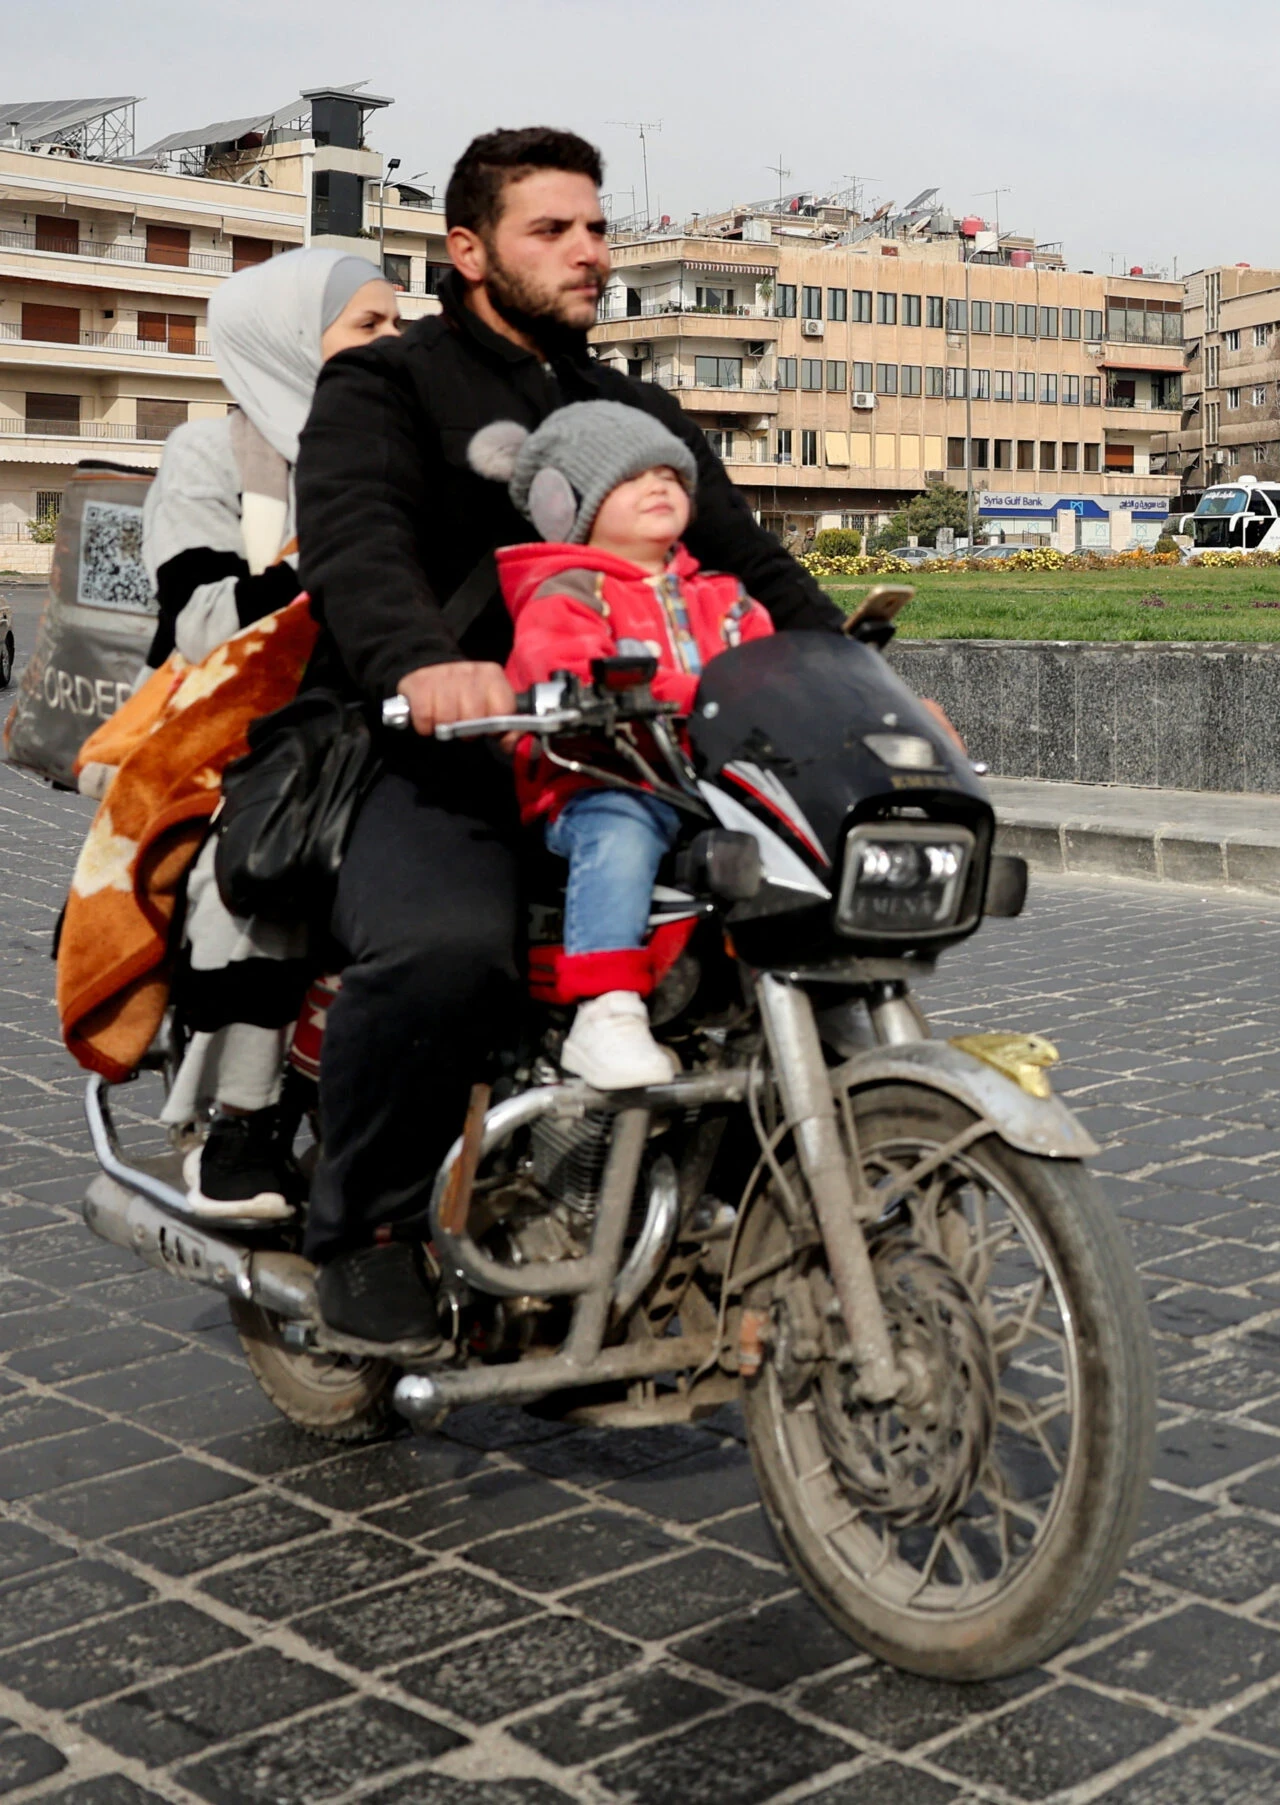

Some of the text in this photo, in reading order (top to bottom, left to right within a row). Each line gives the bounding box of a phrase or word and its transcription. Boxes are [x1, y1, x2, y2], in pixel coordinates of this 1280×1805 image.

[983, 495, 1043, 507] Syria Gulf Bank
[1157, 501, 1167, 510] بنك
